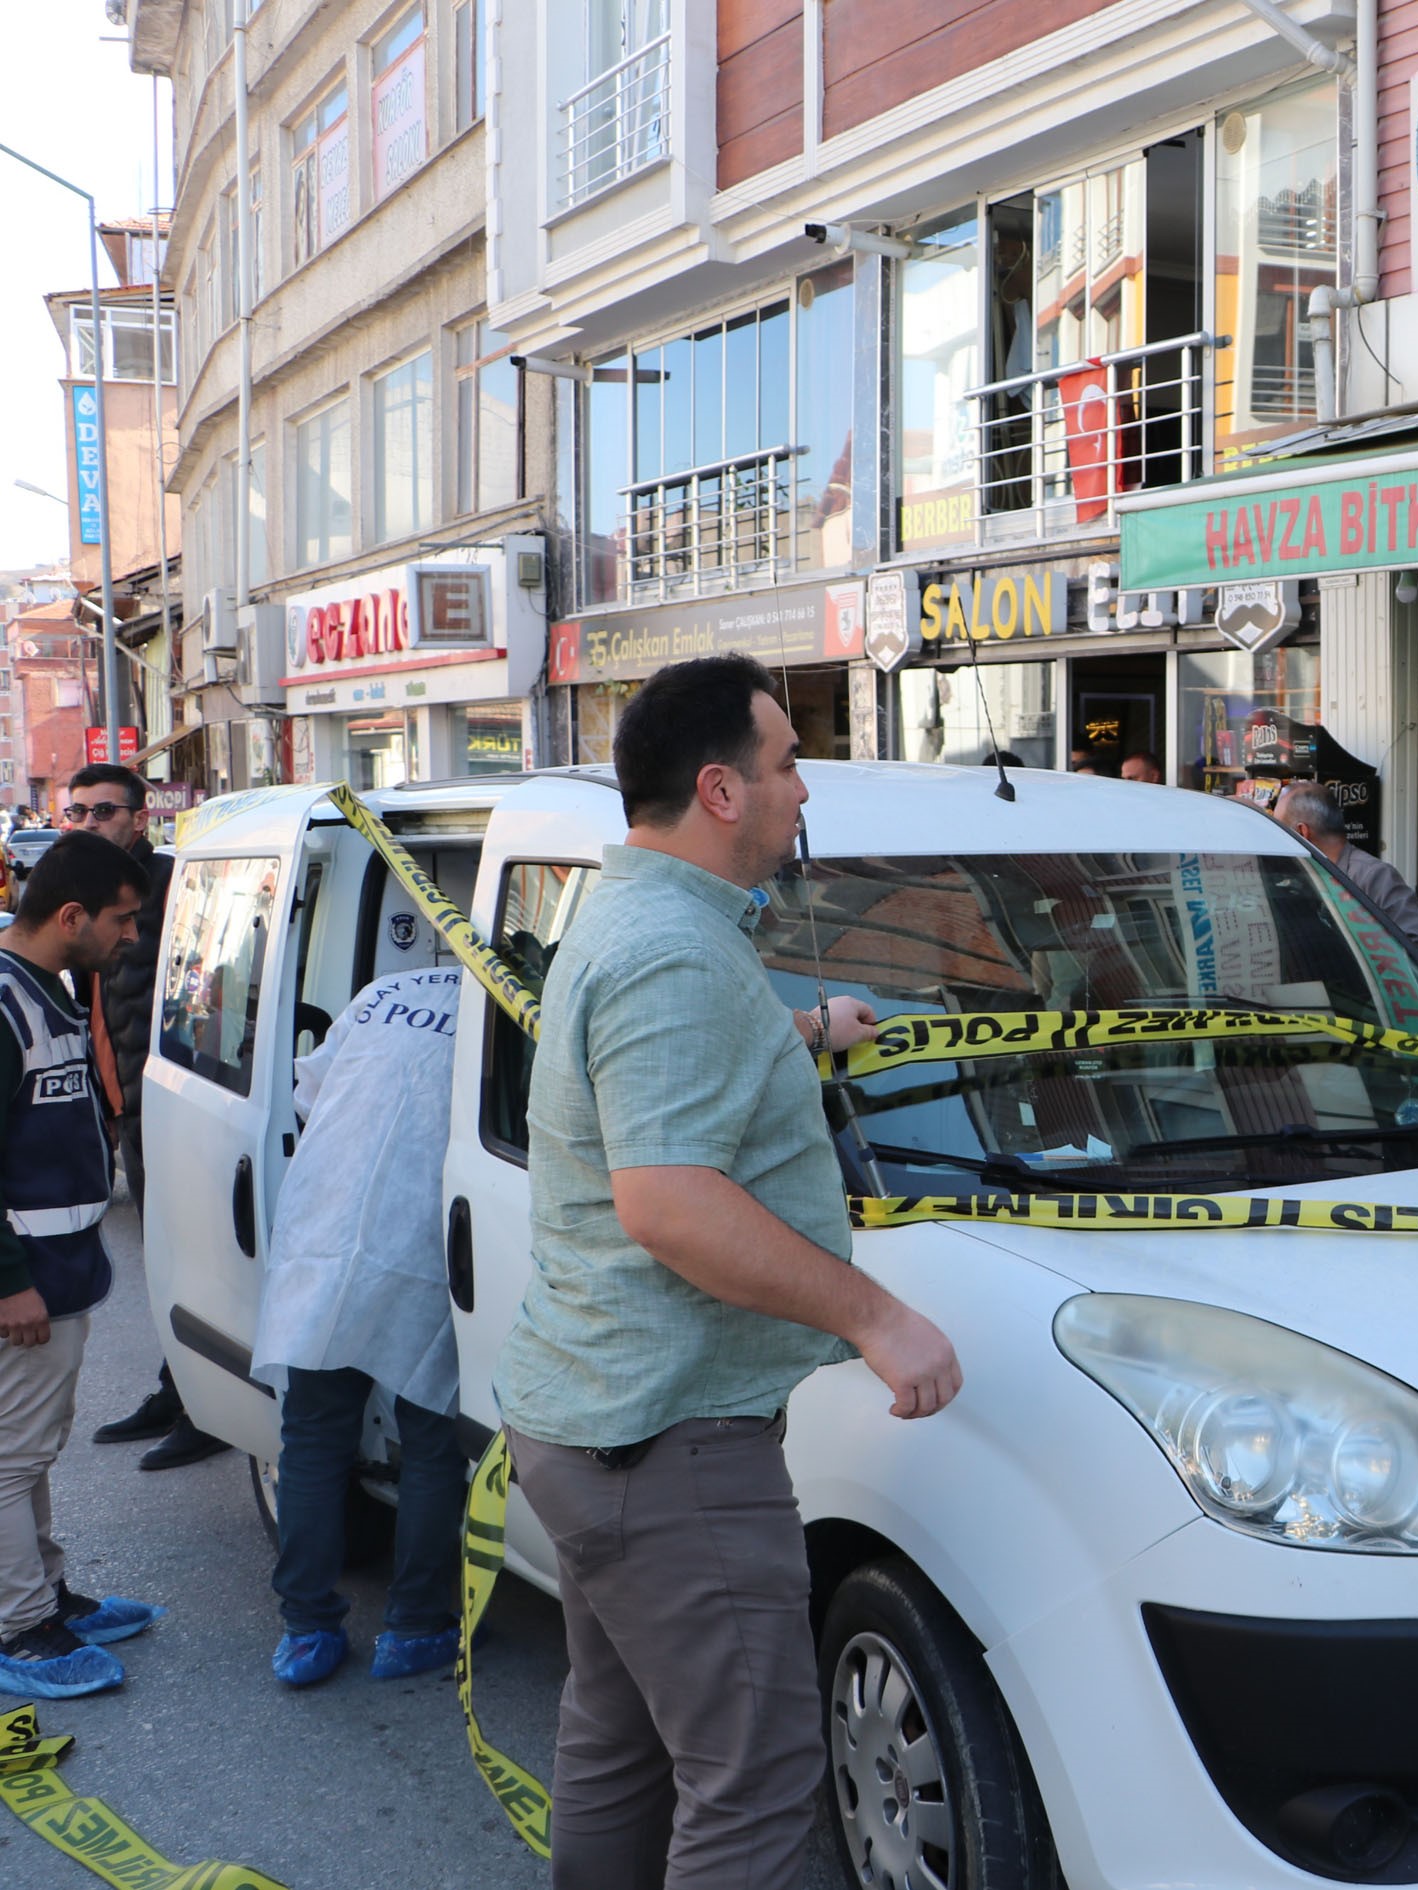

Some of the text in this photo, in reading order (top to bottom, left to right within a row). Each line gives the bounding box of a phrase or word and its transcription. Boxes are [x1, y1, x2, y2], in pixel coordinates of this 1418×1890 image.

[78, 422, 101, 512] DEVA
[902, 493, 972, 540] BERBER
[1205, 494, 1326, 571] HAVZA
[432, 583, 470, 630] E
[920, 571, 1052, 640] SALON
[672, 623, 714, 655] Emlak
[355, 981, 401, 1025] OLAY
[876, 1014, 1039, 1057] POLİS
